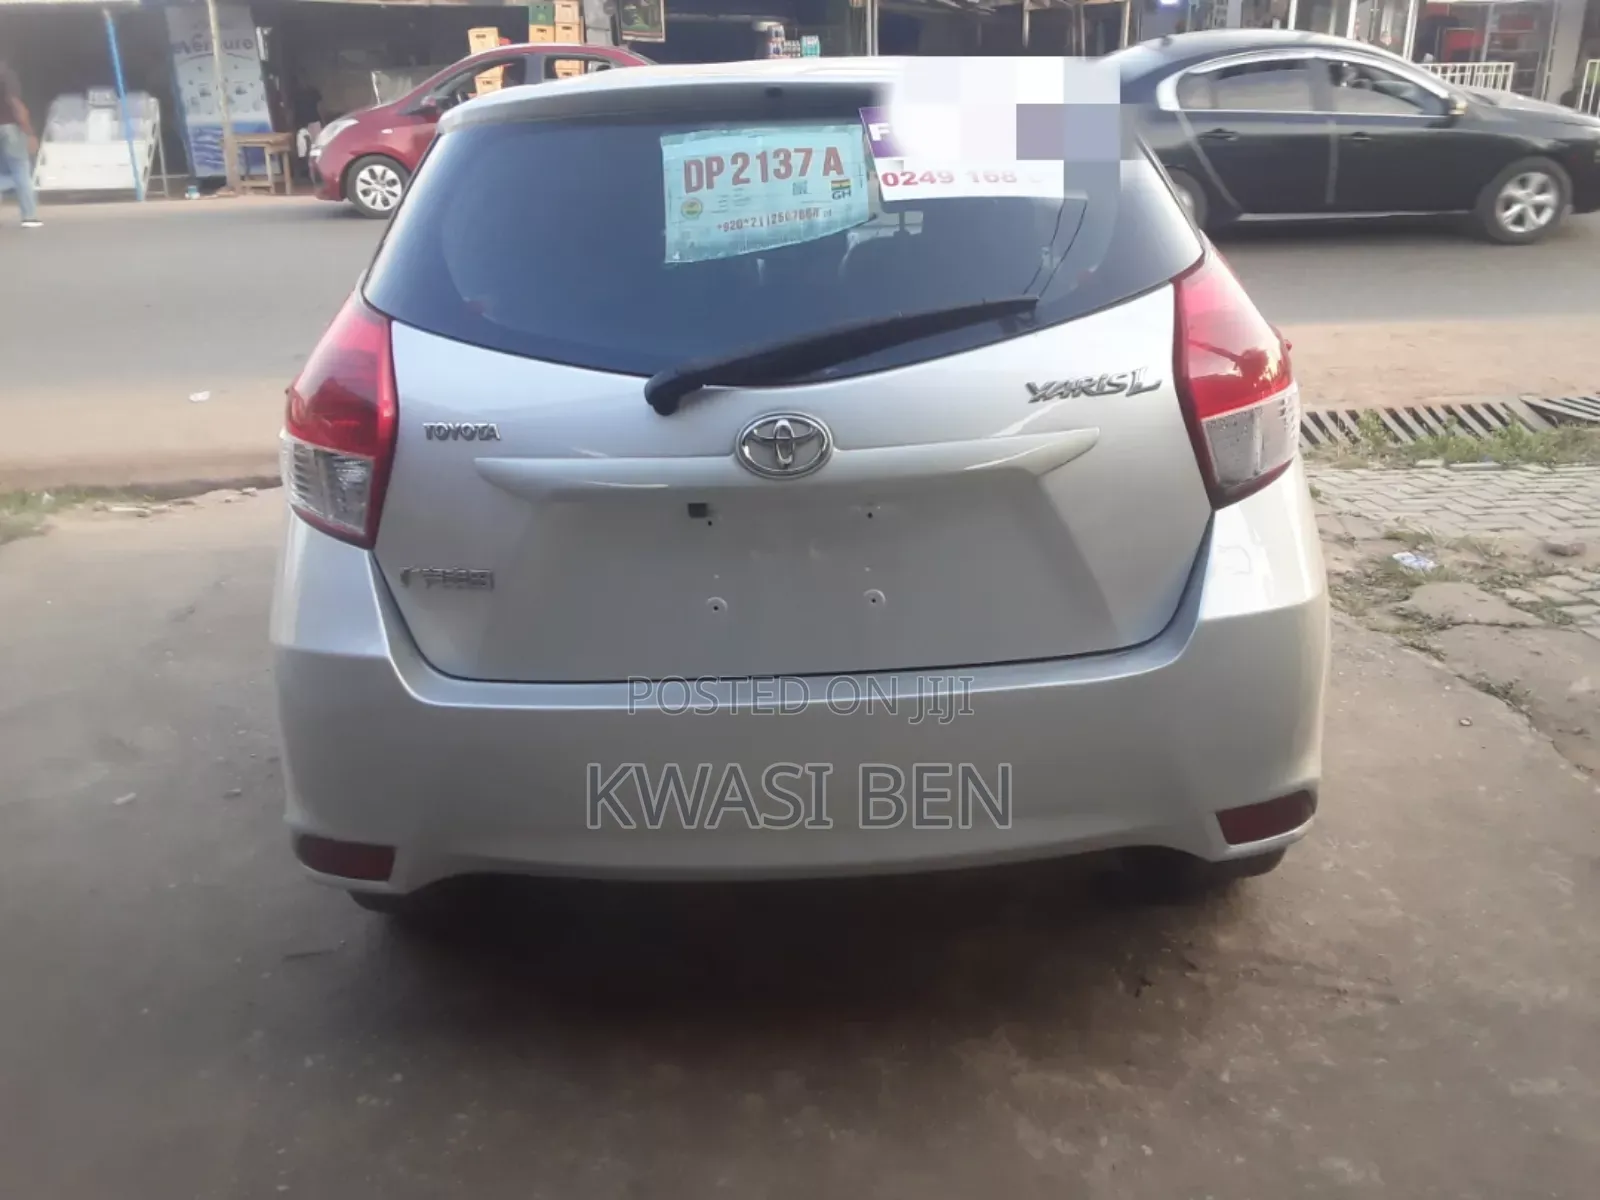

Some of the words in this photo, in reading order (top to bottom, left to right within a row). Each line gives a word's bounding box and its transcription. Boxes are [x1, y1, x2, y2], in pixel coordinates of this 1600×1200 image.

[684, 156, 725, 193] DP
[730, 148, 813, 186] 2137
[822, 146, 845, 177] A
[881, 170, 955, 187] 0249
[966, 170, 1018, 184] 168
[831, 188, 852, 200] GH
[422, 422, 501, 441] TOYOTA
